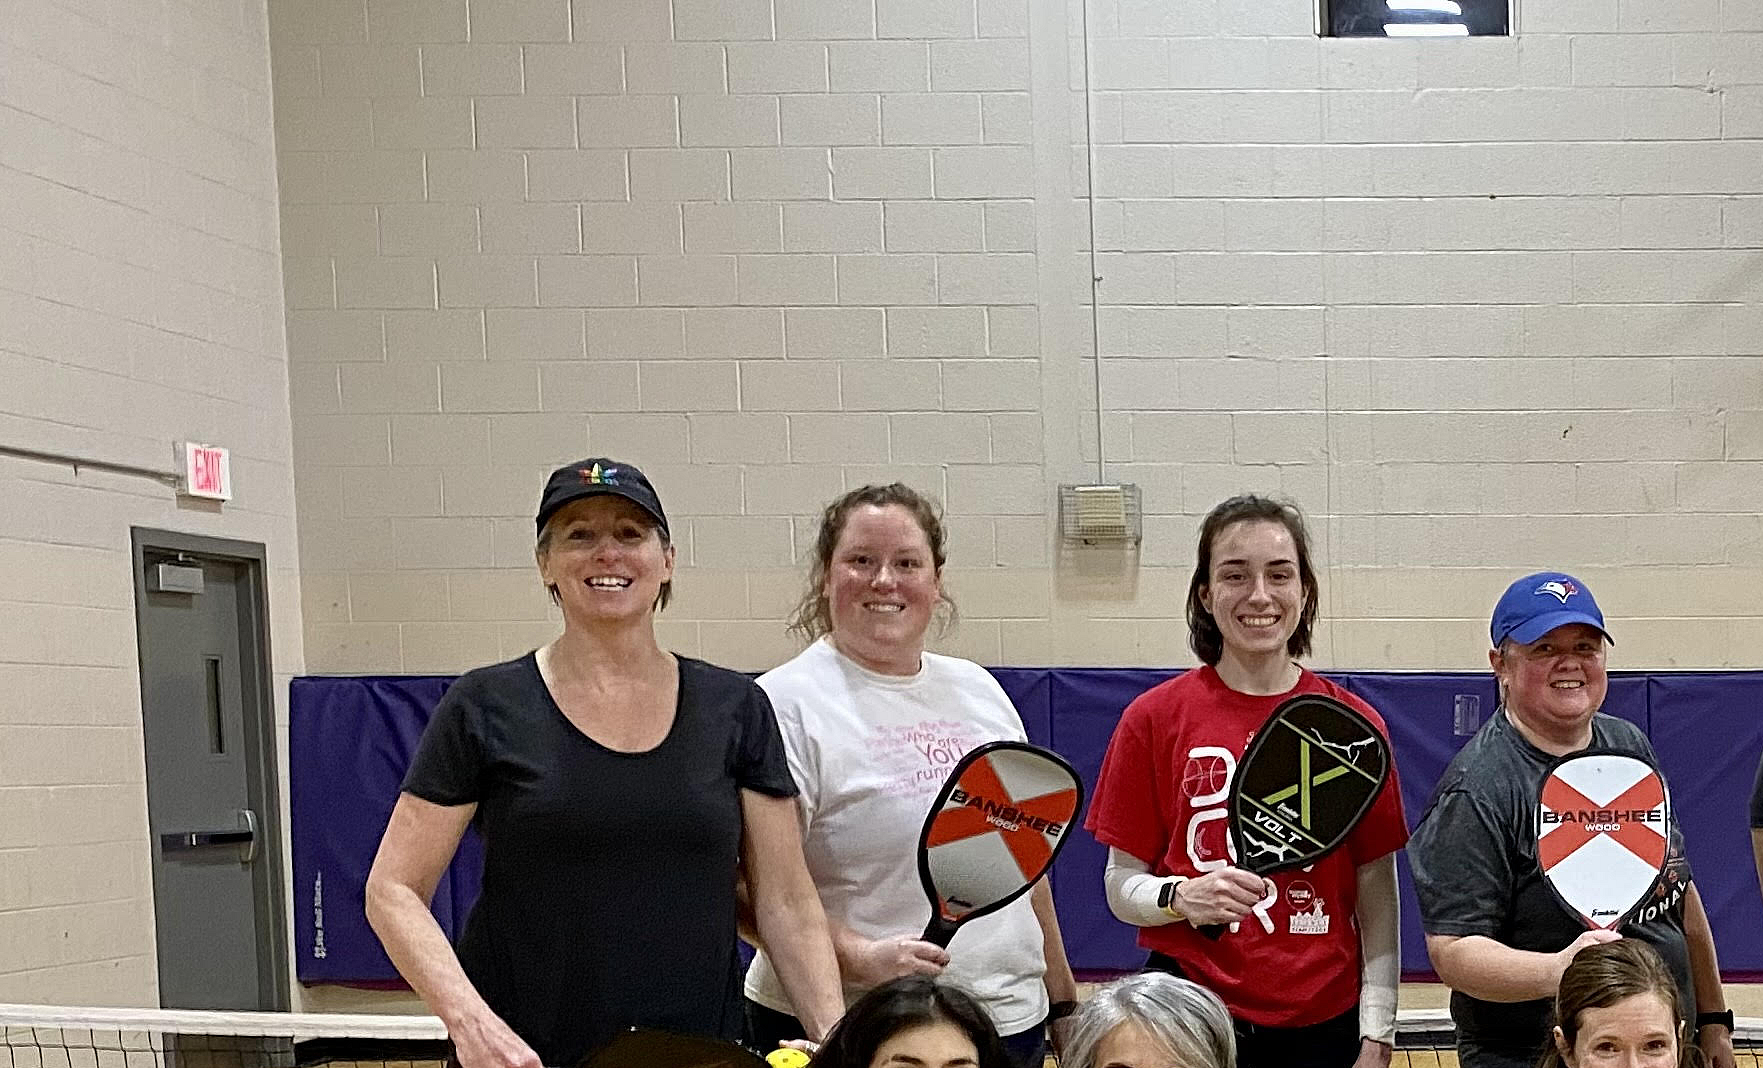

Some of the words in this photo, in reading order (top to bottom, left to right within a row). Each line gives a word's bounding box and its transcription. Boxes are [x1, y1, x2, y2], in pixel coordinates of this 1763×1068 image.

[194, 448, 223, 494] EXIT
[914, 743, 964, 766] YOU
[949, 788, 1064, 838] BANSHEE
[1254, 811, 1302, 843] VOLT
[1542, 809, 1662, 824] BANSHEE
[1585, 823, 1621, 832] WOOD
[1629, 881, 1687, 925] IONAL
